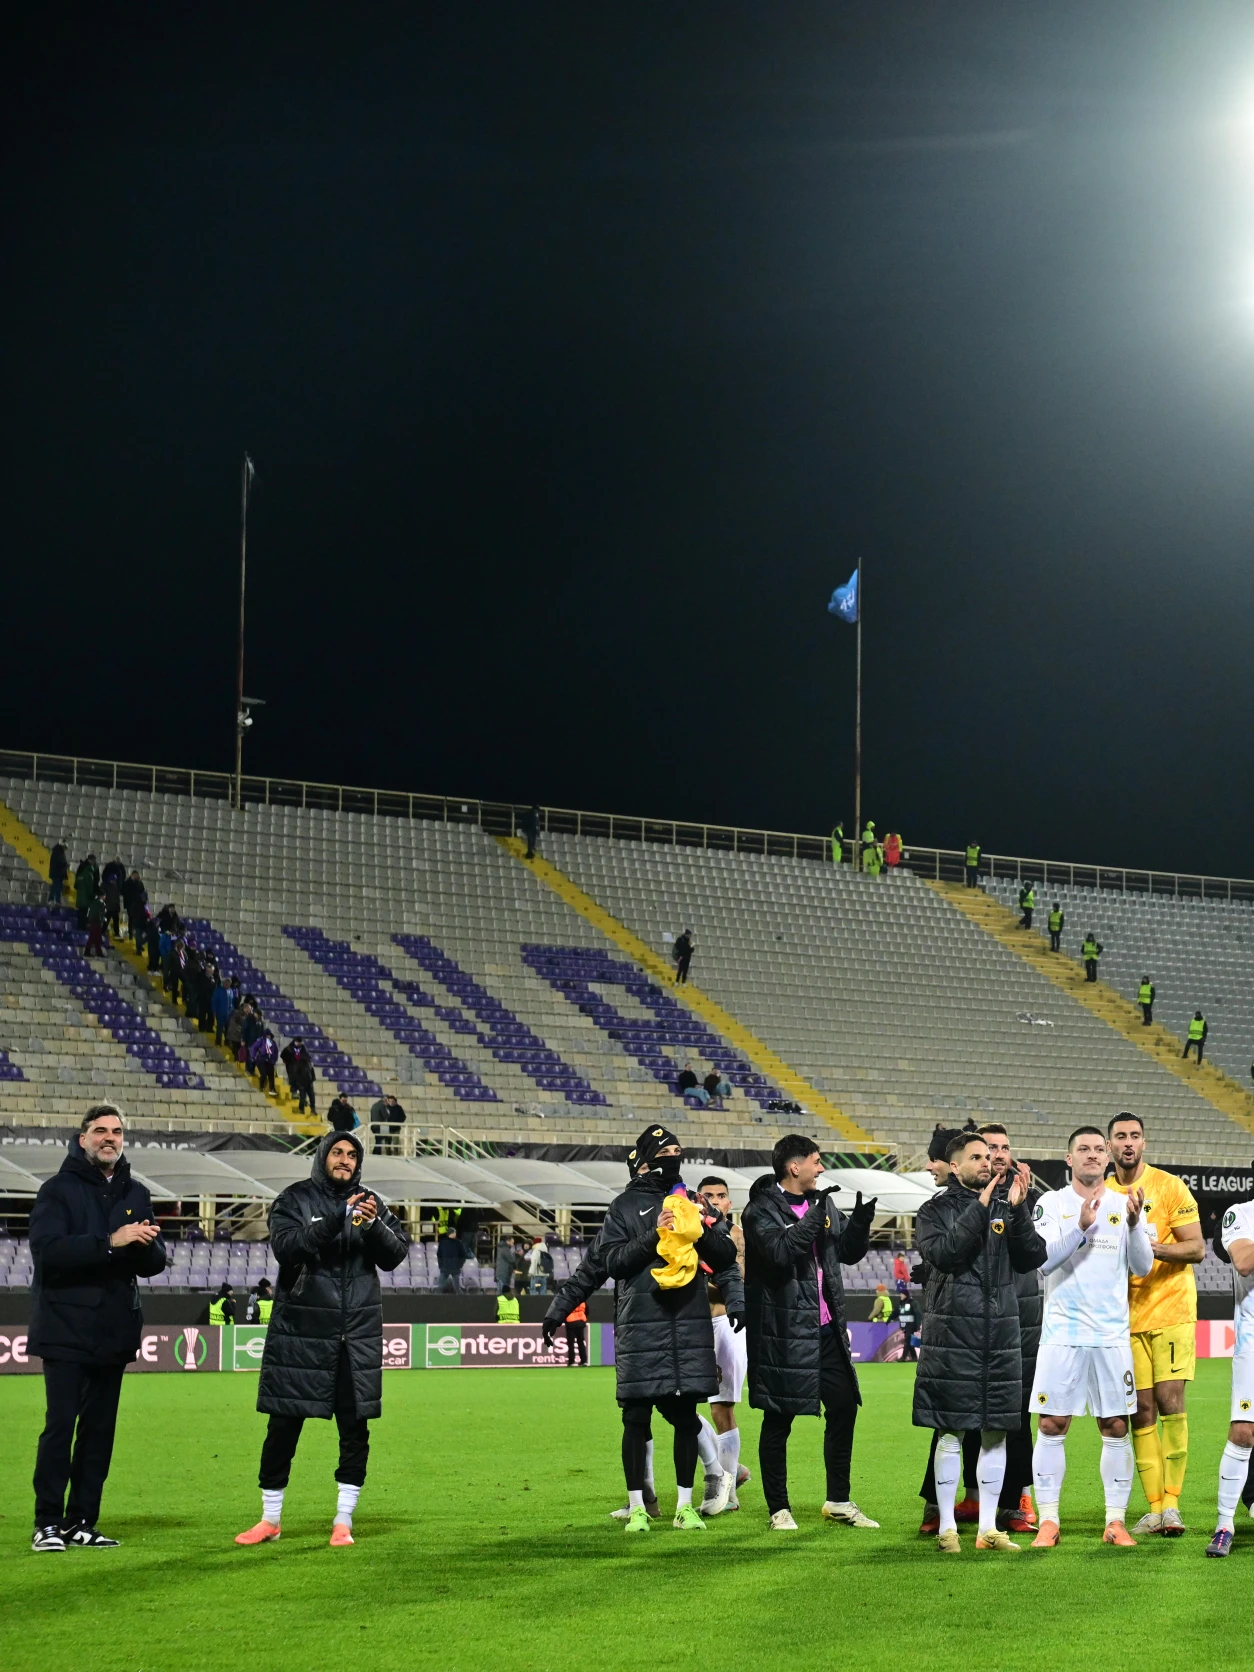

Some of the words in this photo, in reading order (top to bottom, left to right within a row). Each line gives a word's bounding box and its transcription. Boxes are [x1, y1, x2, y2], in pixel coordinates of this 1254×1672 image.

[1202, 1175, 1254, 1192] LEAGUE
[1168, 1341, 1175, 1364] 1
[1123, 1370, 1134, 1396] 9
